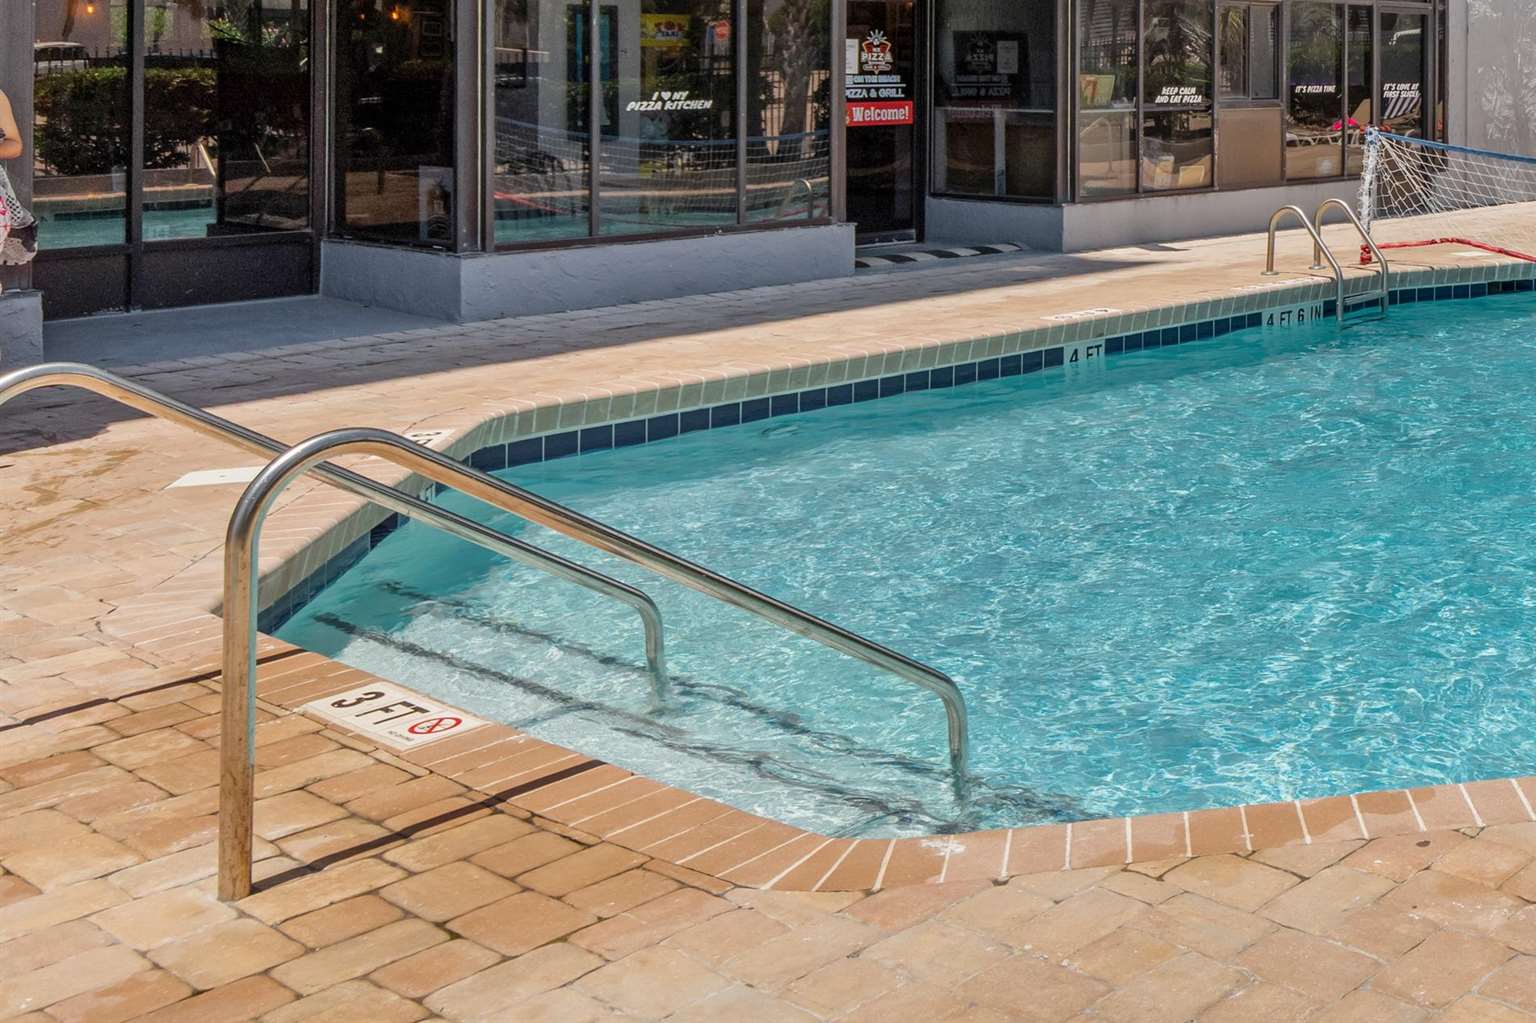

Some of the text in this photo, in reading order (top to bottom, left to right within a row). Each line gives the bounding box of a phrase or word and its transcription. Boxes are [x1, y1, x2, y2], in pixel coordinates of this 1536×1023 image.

[860, 51, 894, 63] PIZZA
[1161, 86, 1196, 95] KEEP CALM
[1295, 85, 1307, 93] IT'S
[1307, 85, 1323, 93] PIZZA
[1383, 82, 1419, 91] IT'S LOVE AT
[652, 91, 659, 101] I
[869, 88, 878, 98] &
[878, 88, 905, 98] GRILL
[1155, 95, 1202, 104] AND EAT PIZZA
[626, 99, 713, 112] PIZZA KITCHEN
[852, 105, 909, 122] Welcome!
[1266, 304, 1322, 326] 4 FT 6 IN
[1069, 344, 1102, 363] 4 FT
[330, 691, 430, 725] 3 FT
